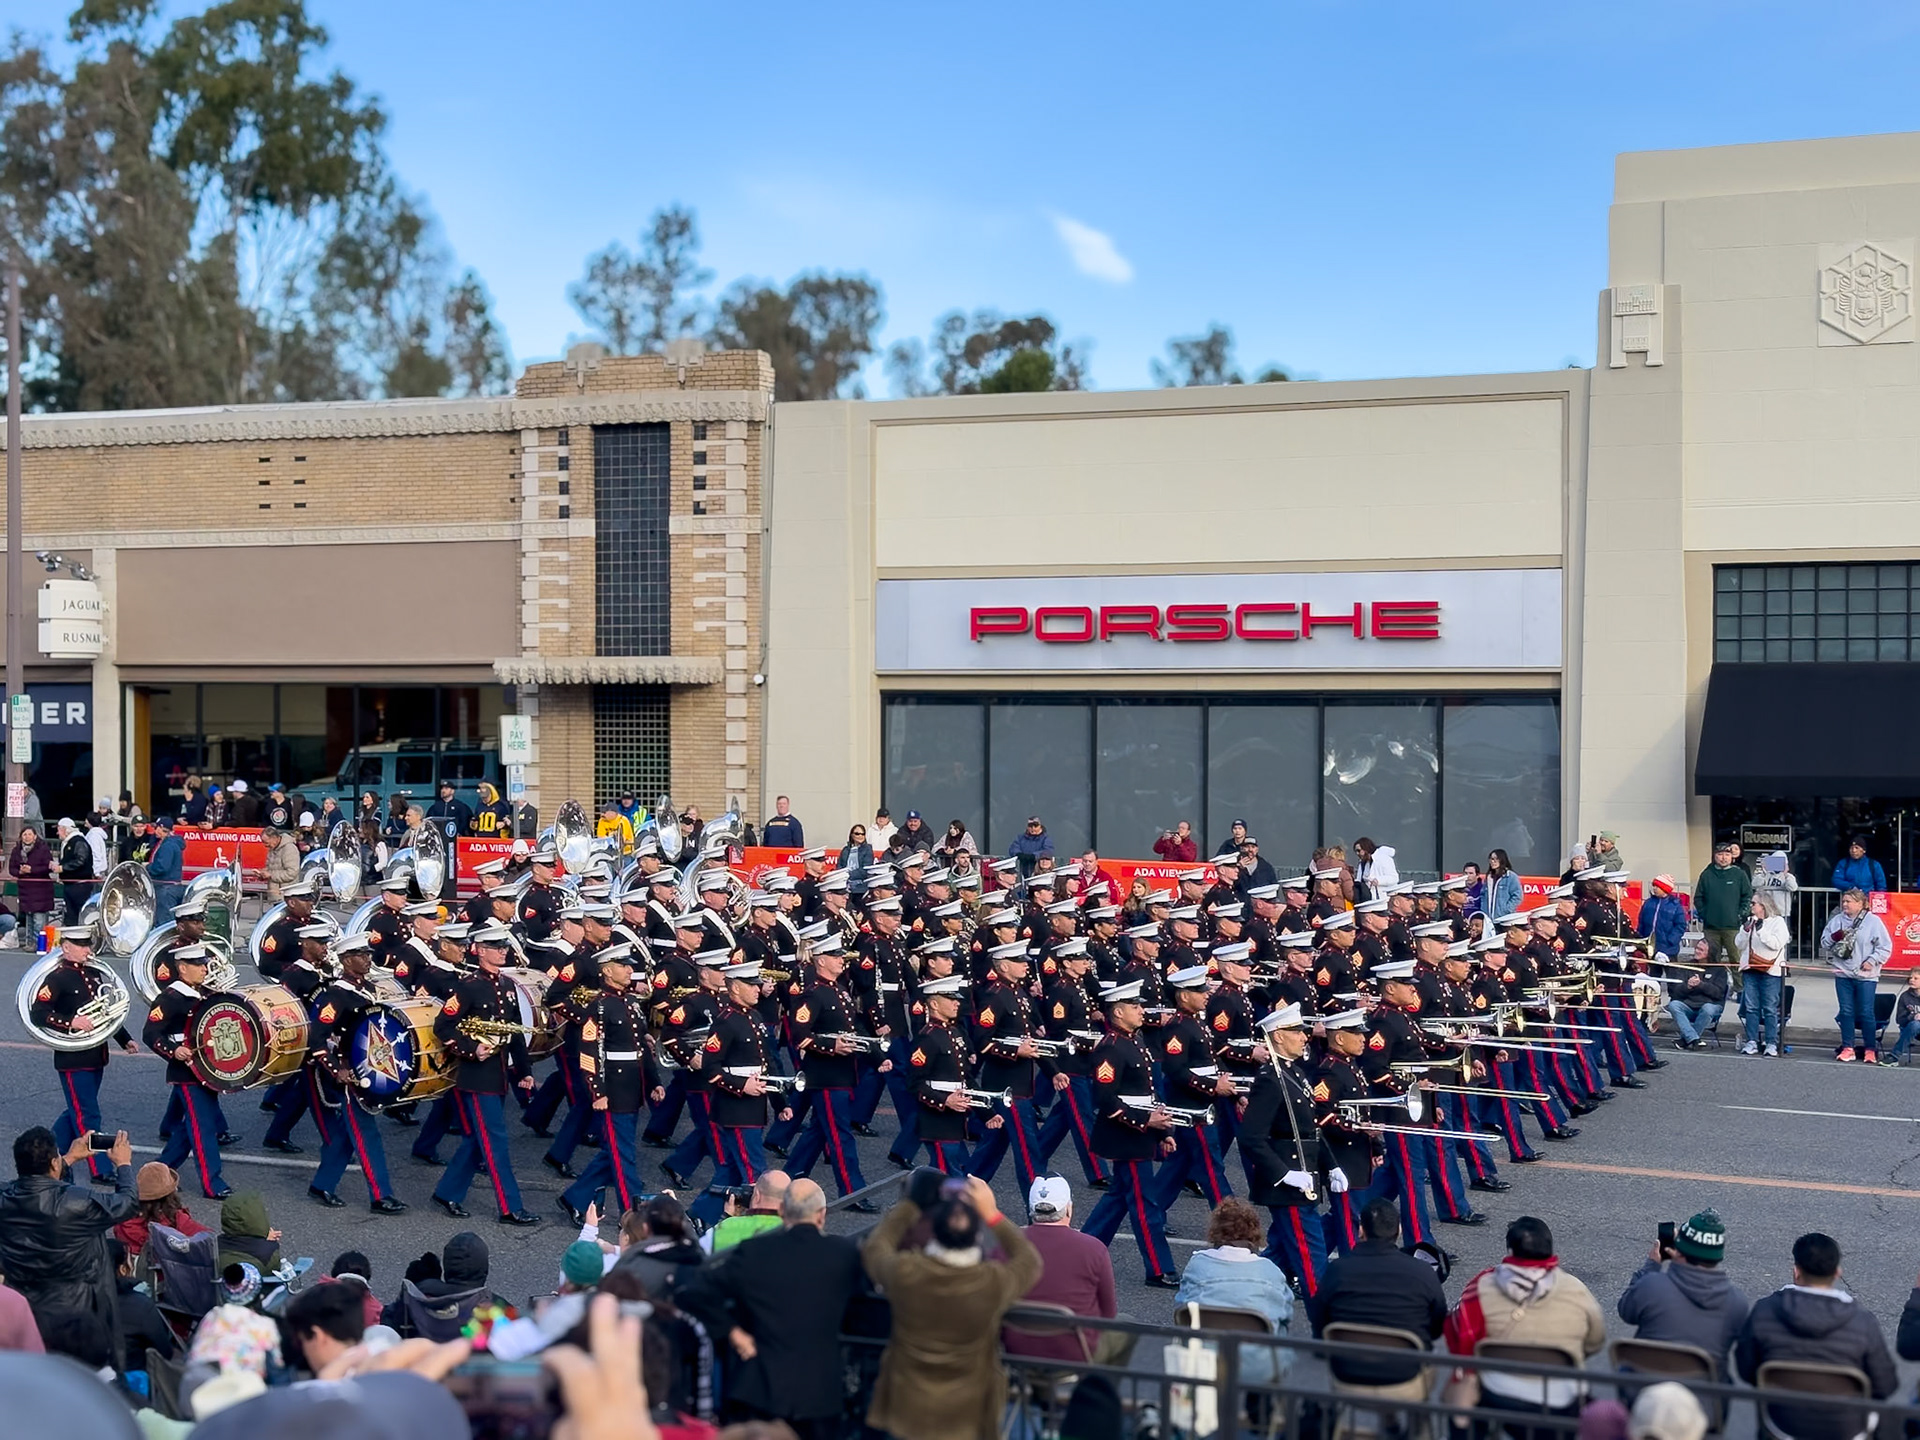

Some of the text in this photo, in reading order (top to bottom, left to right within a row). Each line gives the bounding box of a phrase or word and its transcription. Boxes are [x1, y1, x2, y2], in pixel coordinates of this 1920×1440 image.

[970, 601, 1441, 642] PORSCHE
[509, 730, 523, 740] PAY
[507, 740, 527, 751] HERE
[478, 811, 497, 832] 10
[183, 832, 262, 842] ADA VIEWING AREA
[1743, 831, 1789, 844] RUSNAK
[469, 843, 513, 853] ADA VIEW
[1133, 867, 1156, 877] ADA
[1522, 884, 1540, 894] DA
